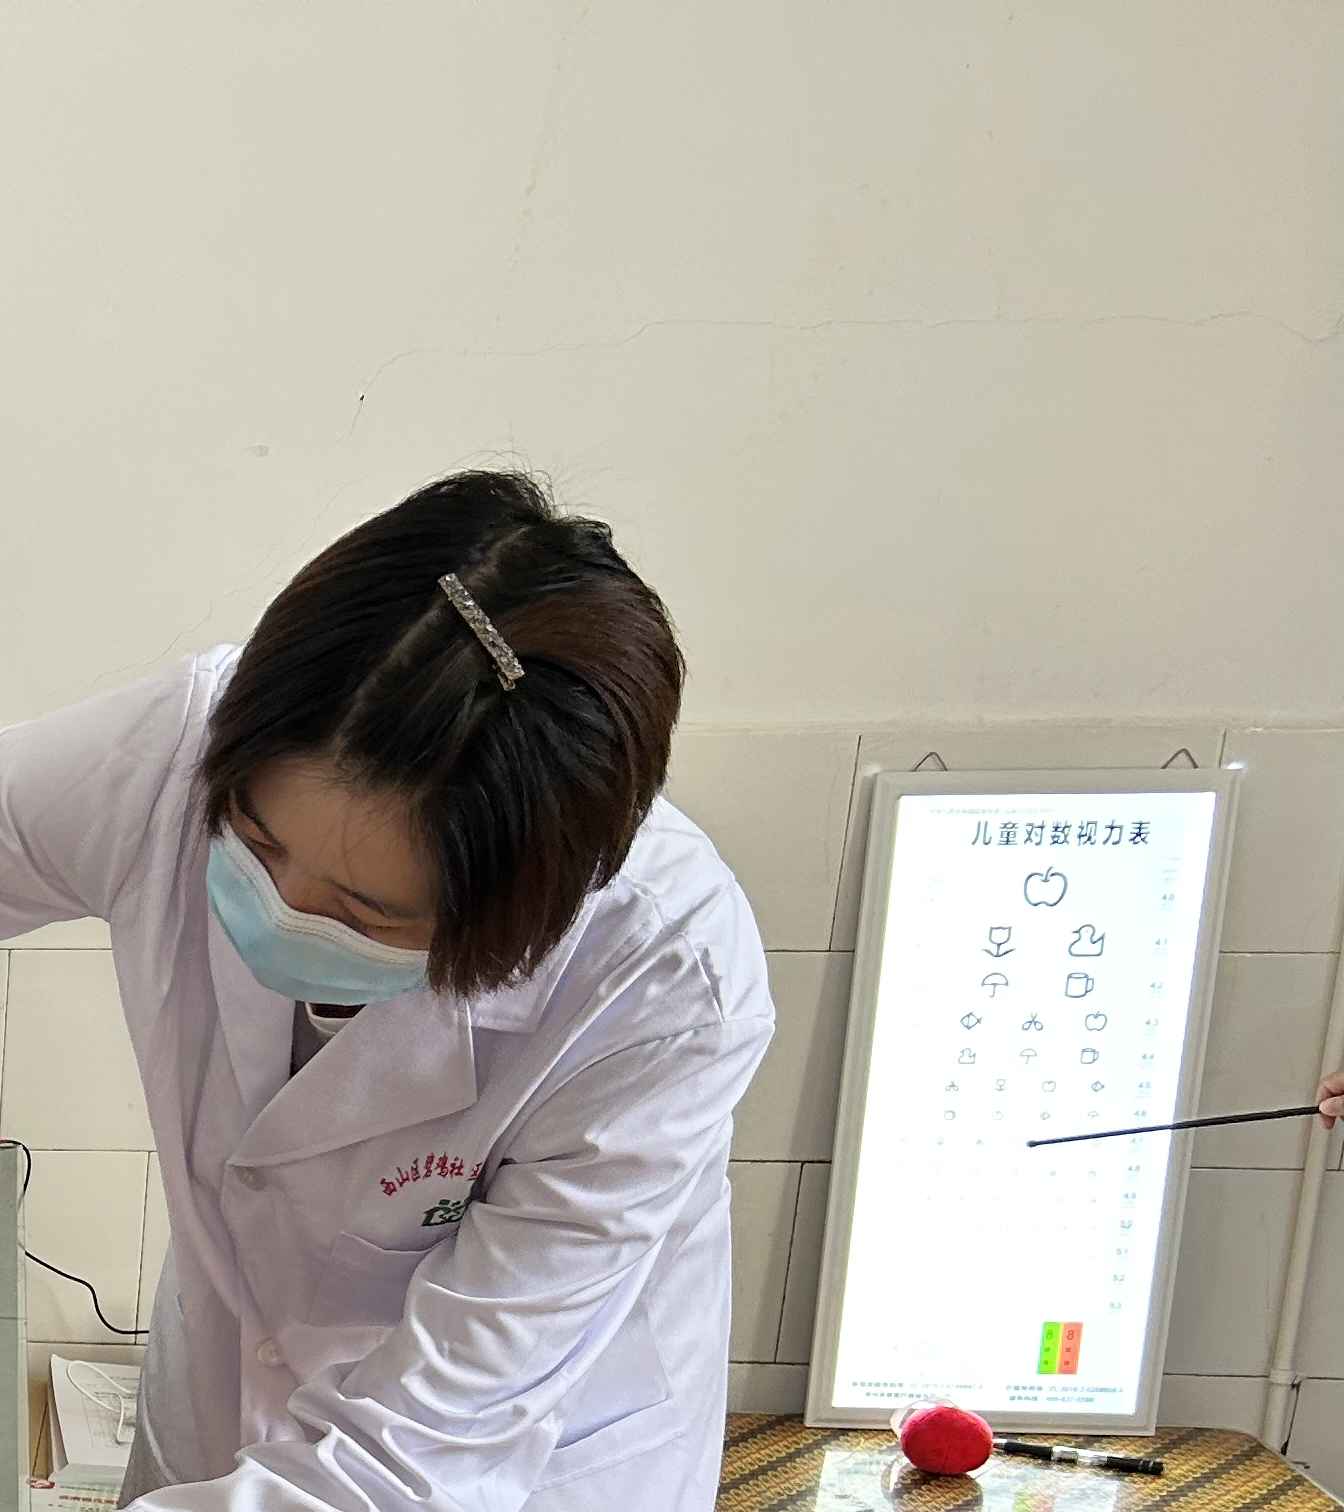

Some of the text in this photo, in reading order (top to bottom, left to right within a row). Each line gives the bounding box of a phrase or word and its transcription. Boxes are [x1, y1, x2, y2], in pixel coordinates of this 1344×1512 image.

[970, 819, 1151, 847] 儿童对数视力表
